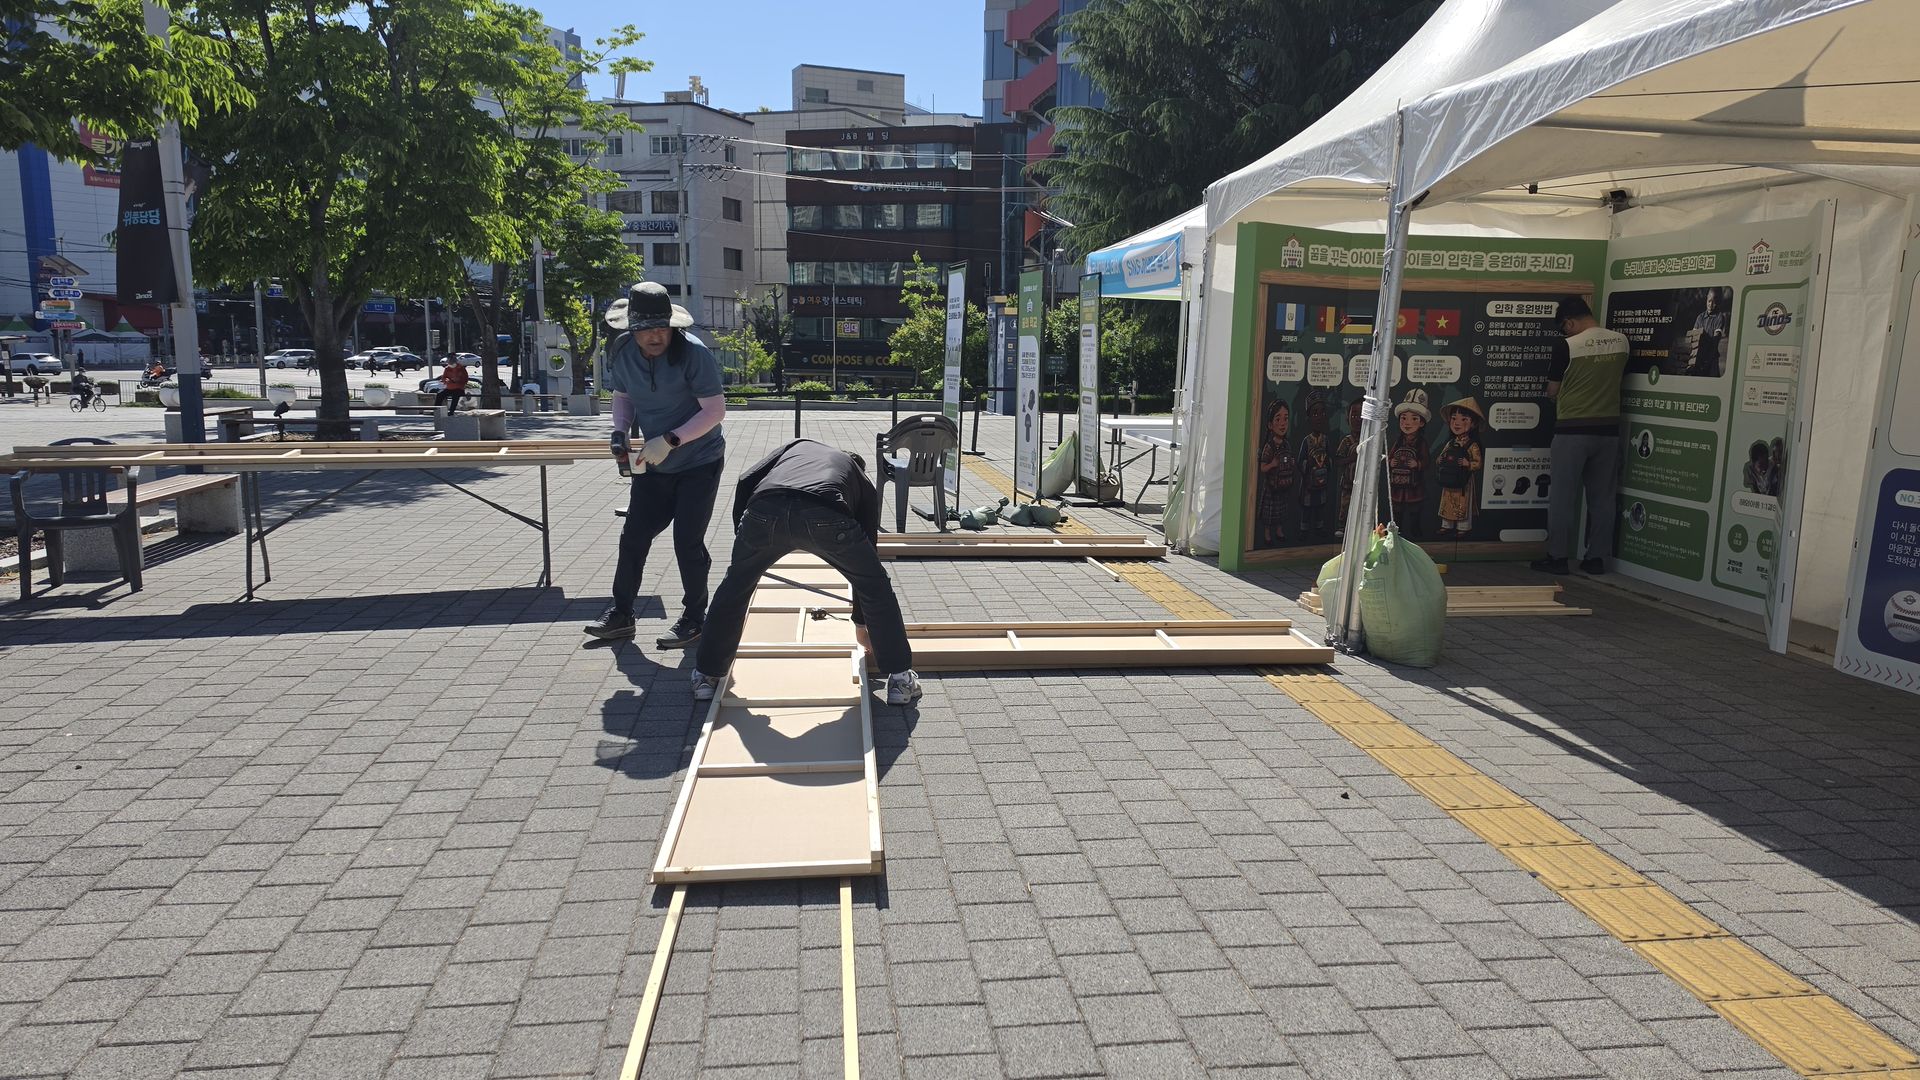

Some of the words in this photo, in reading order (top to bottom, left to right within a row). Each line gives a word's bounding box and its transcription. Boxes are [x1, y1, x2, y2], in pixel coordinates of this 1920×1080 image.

[841, 132, 858, 140] J&B
[123, 208, 160, 226] 위풍당당
[1310, 246, 1328, 262] 꿈을
[1331, 248, 1349, 264] 꾸는
[1403, 251, 1445, 267] 이들의
[1448, 253, 1485, 268] 입학을
[1489, 254, 1527, 269] 응원해
[1530, 255, 1572, 270] 주세요!
[1624, 261, 1642, 275] 누구나
[1658, 258, 1667, 273] 수
[1666, 257, 1680, 272] 있는
[1681, 255, 1697, 271] 꿈의
[1698, 254, 1716, 270] 학교
[1494, 303, 1513, 314] 입학
[1516, 304, 1553, 315] 응원방법
[1757, 312, 1793, 328] Dinos
[811, 354, 863, 365] COMPOSE
[1892, 520, 1908, 532] 다시
[1890, 532, 1898, 541] 이
[1888, 543, 1912, 556] 마음껏
[1886, 554, 1917, 568] 도전하길
